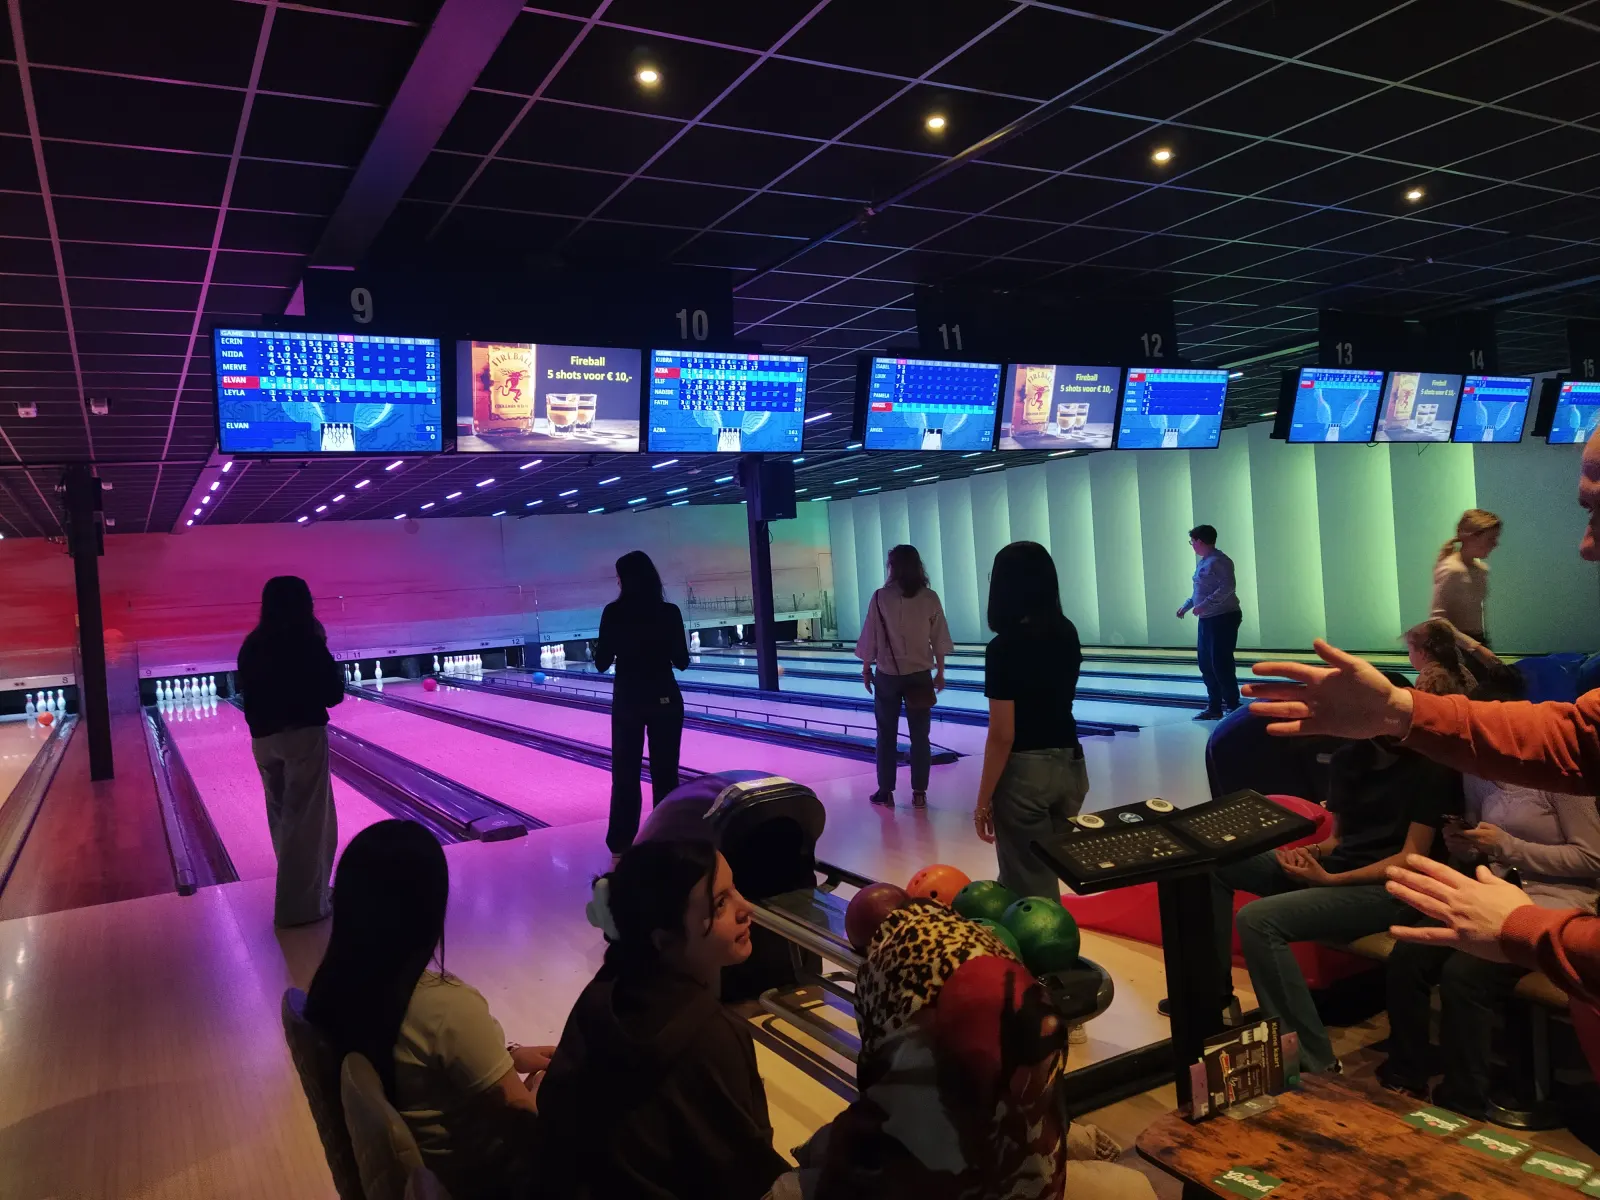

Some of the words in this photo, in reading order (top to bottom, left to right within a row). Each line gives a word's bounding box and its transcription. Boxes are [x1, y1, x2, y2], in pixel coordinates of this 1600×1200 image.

[350, 288, 373, 324] 9
[676, 308, 708, 341] 10
[938, 324, 962, 350] 11
[1140, 333, 1164, 358] 12
[570, 356, 606, 366] Fireball
[1336, 342, 1353, 365] 13
[1470, 350, 1485, 370] 14
[547, 370, 554, 379] 5
[556, 369, 581, 379] shots
[607, 372, 613, 381] €
[615, 372, 632, 383] 10,-
[1582, 358, 1594, 378] 15
